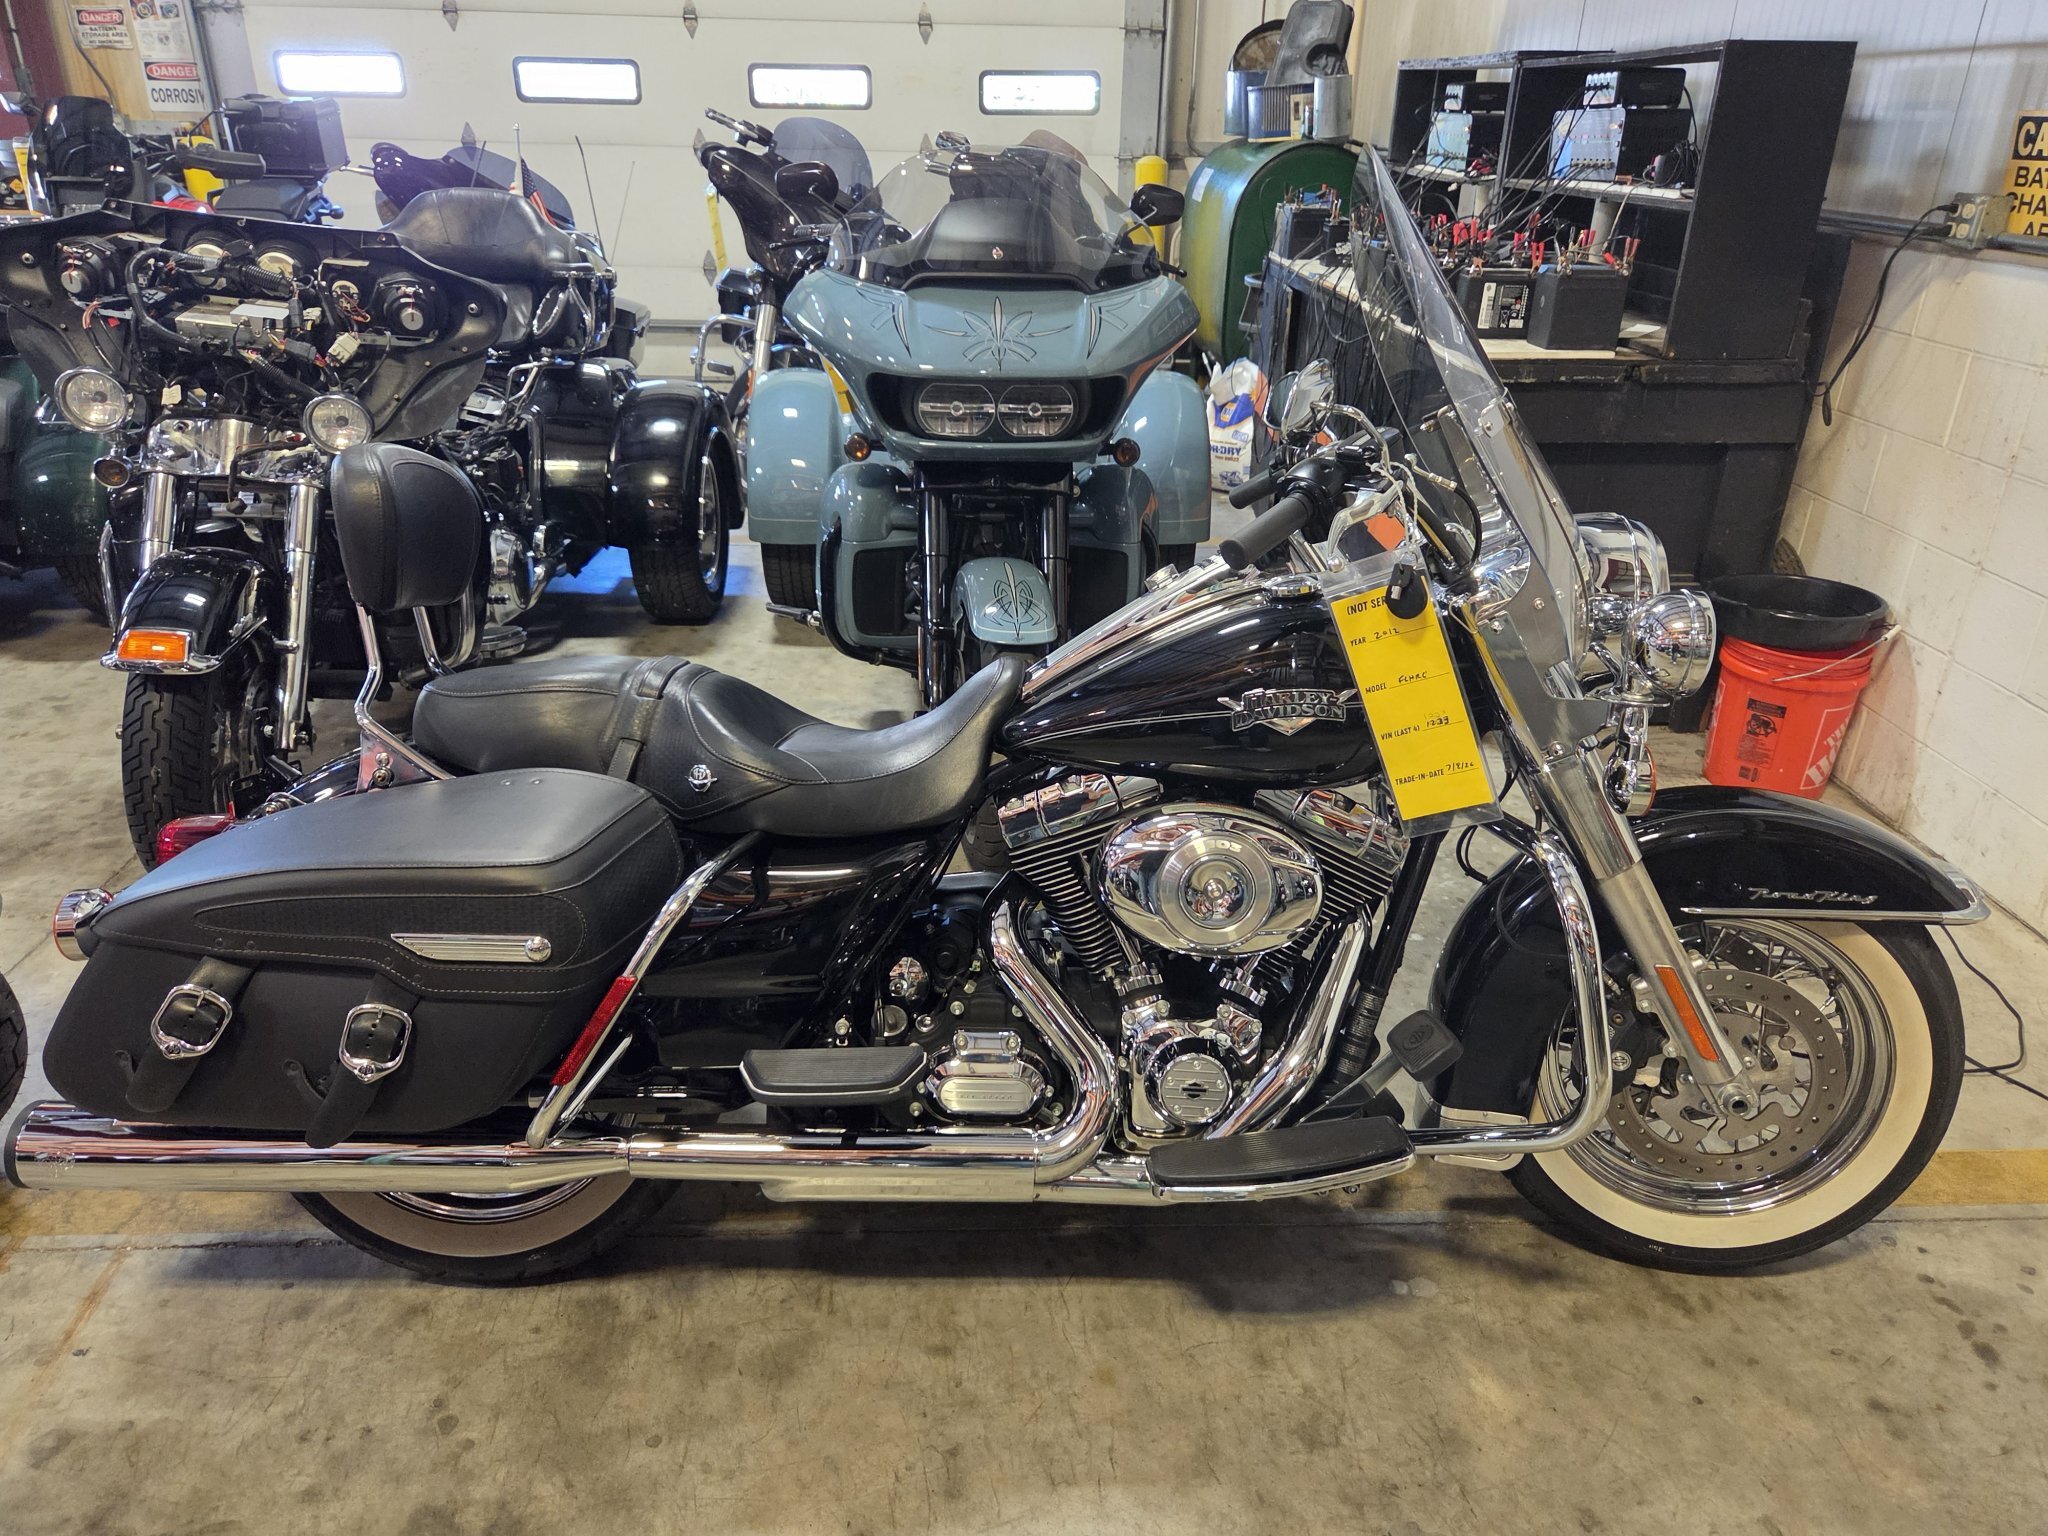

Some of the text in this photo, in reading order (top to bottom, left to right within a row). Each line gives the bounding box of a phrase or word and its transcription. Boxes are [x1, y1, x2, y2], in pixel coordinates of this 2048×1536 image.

[80, 12, 120, 21] DANGER
[1346, 601, 1368, 615] (NOT
[1350, 628, 1400, 647] YEAR 2012
[1365, 683, 1387, 694] MODEL
[1234, 704, 1343, 728] DAVIDSON
[1380, 732, 1393, 740] VIN
[1394, 727, 1411, 737] (LAST
[1395, 769, 1444, 786] TRADE-IN-DATE
